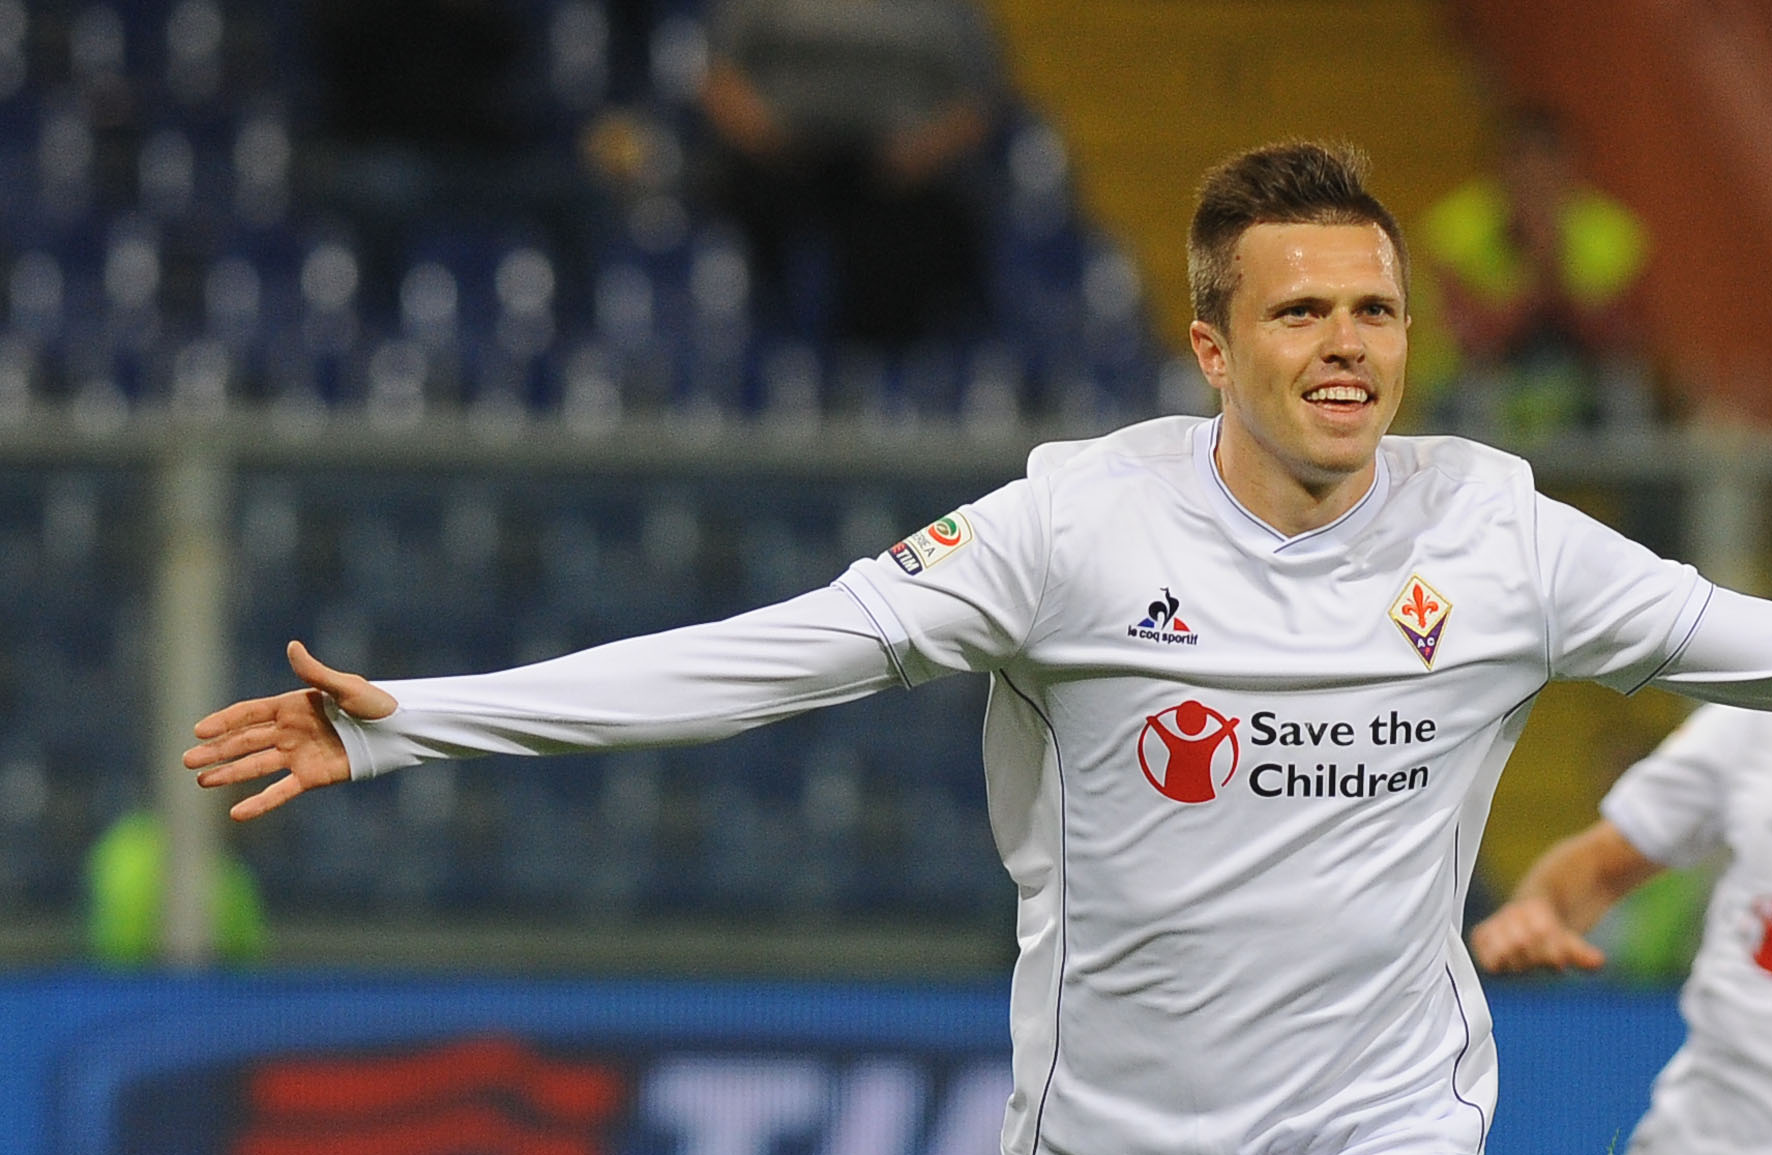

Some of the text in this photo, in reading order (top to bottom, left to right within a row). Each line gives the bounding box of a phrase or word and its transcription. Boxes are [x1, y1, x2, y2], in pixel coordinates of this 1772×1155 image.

[897, 551, 920, 572] TIM
[1127, 624, 1199, 646] le coq sportif
[1250, 708, 1437, 749] Save the
[1247, 760, 1430, 800] Children
